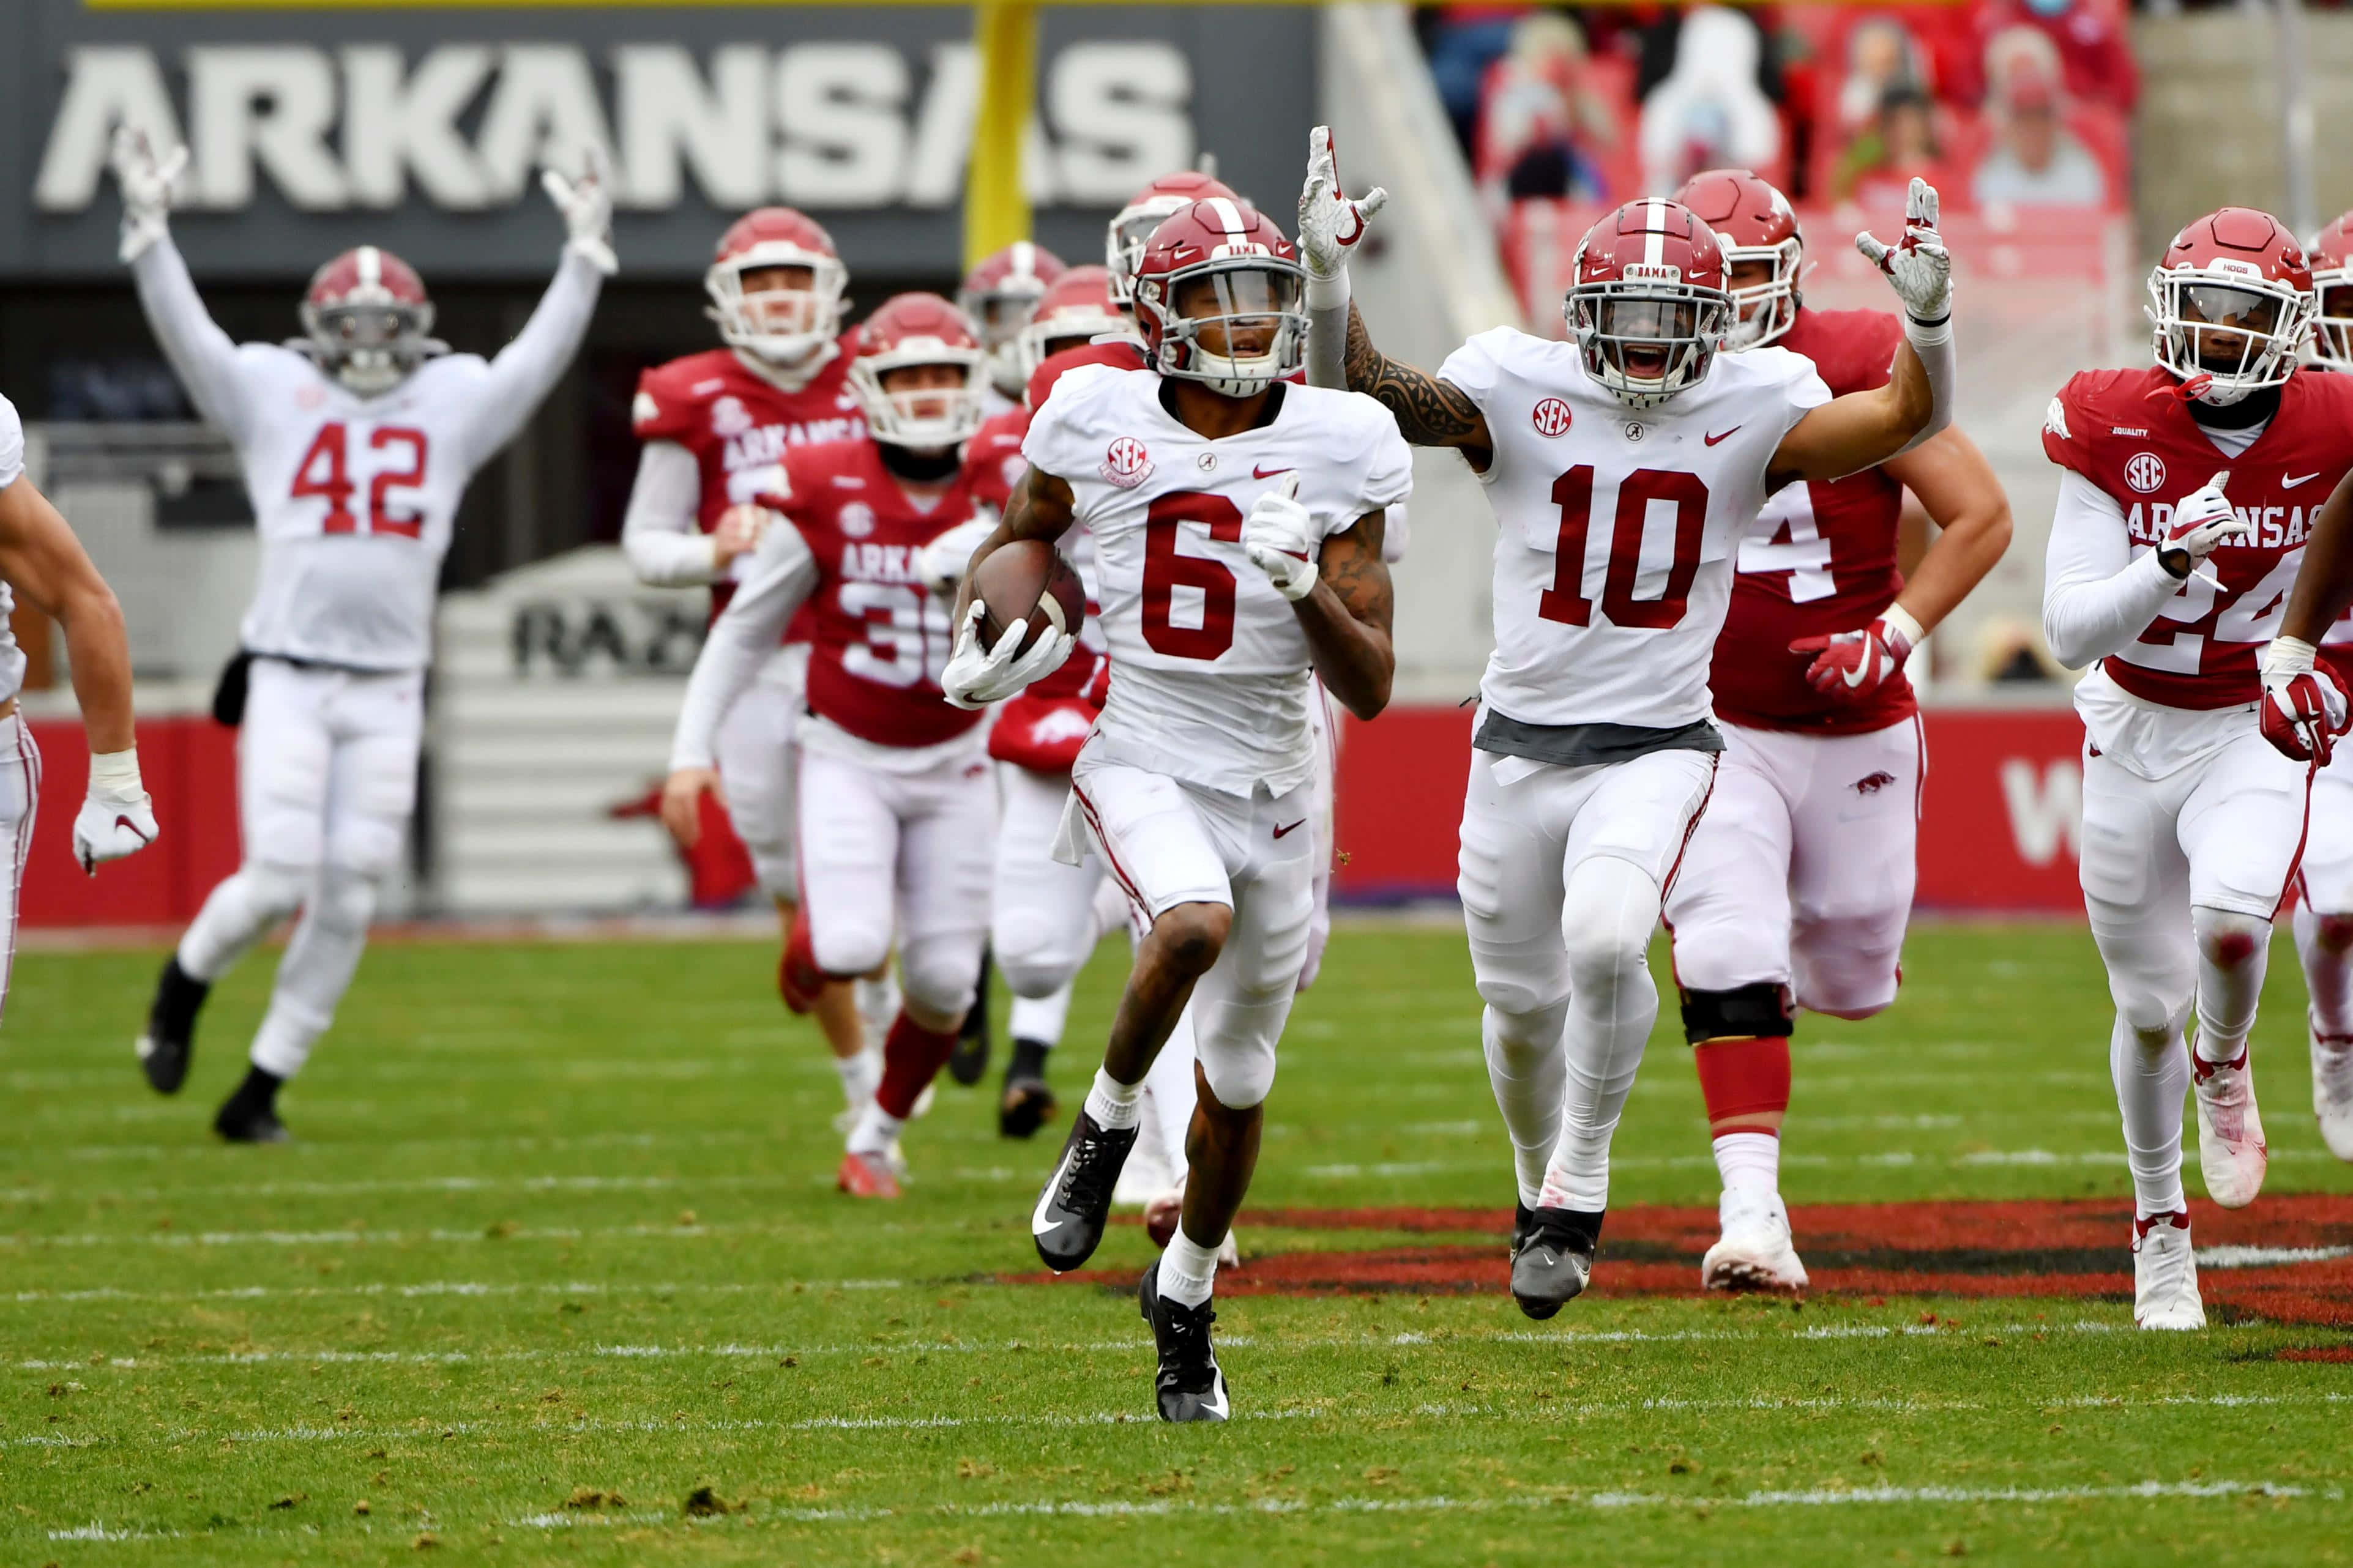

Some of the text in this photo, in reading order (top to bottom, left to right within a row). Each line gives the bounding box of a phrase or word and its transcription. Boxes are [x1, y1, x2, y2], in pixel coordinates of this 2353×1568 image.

[1637, 266, 1667, 279] BAMA
[2223, 263, 2248, 275] HOGS
[1535, 399, 1570, 435] SEC
[2111, 426, 2149, 437] EQUALITY
[1108, 437, 1146, 474] SEC
[2128, 455, 2162, 490] SEC
[291, 423, 428, 539] 42
[1538, 463, 1709, 630] 10
[1141, 491, 1244, 661] 6
